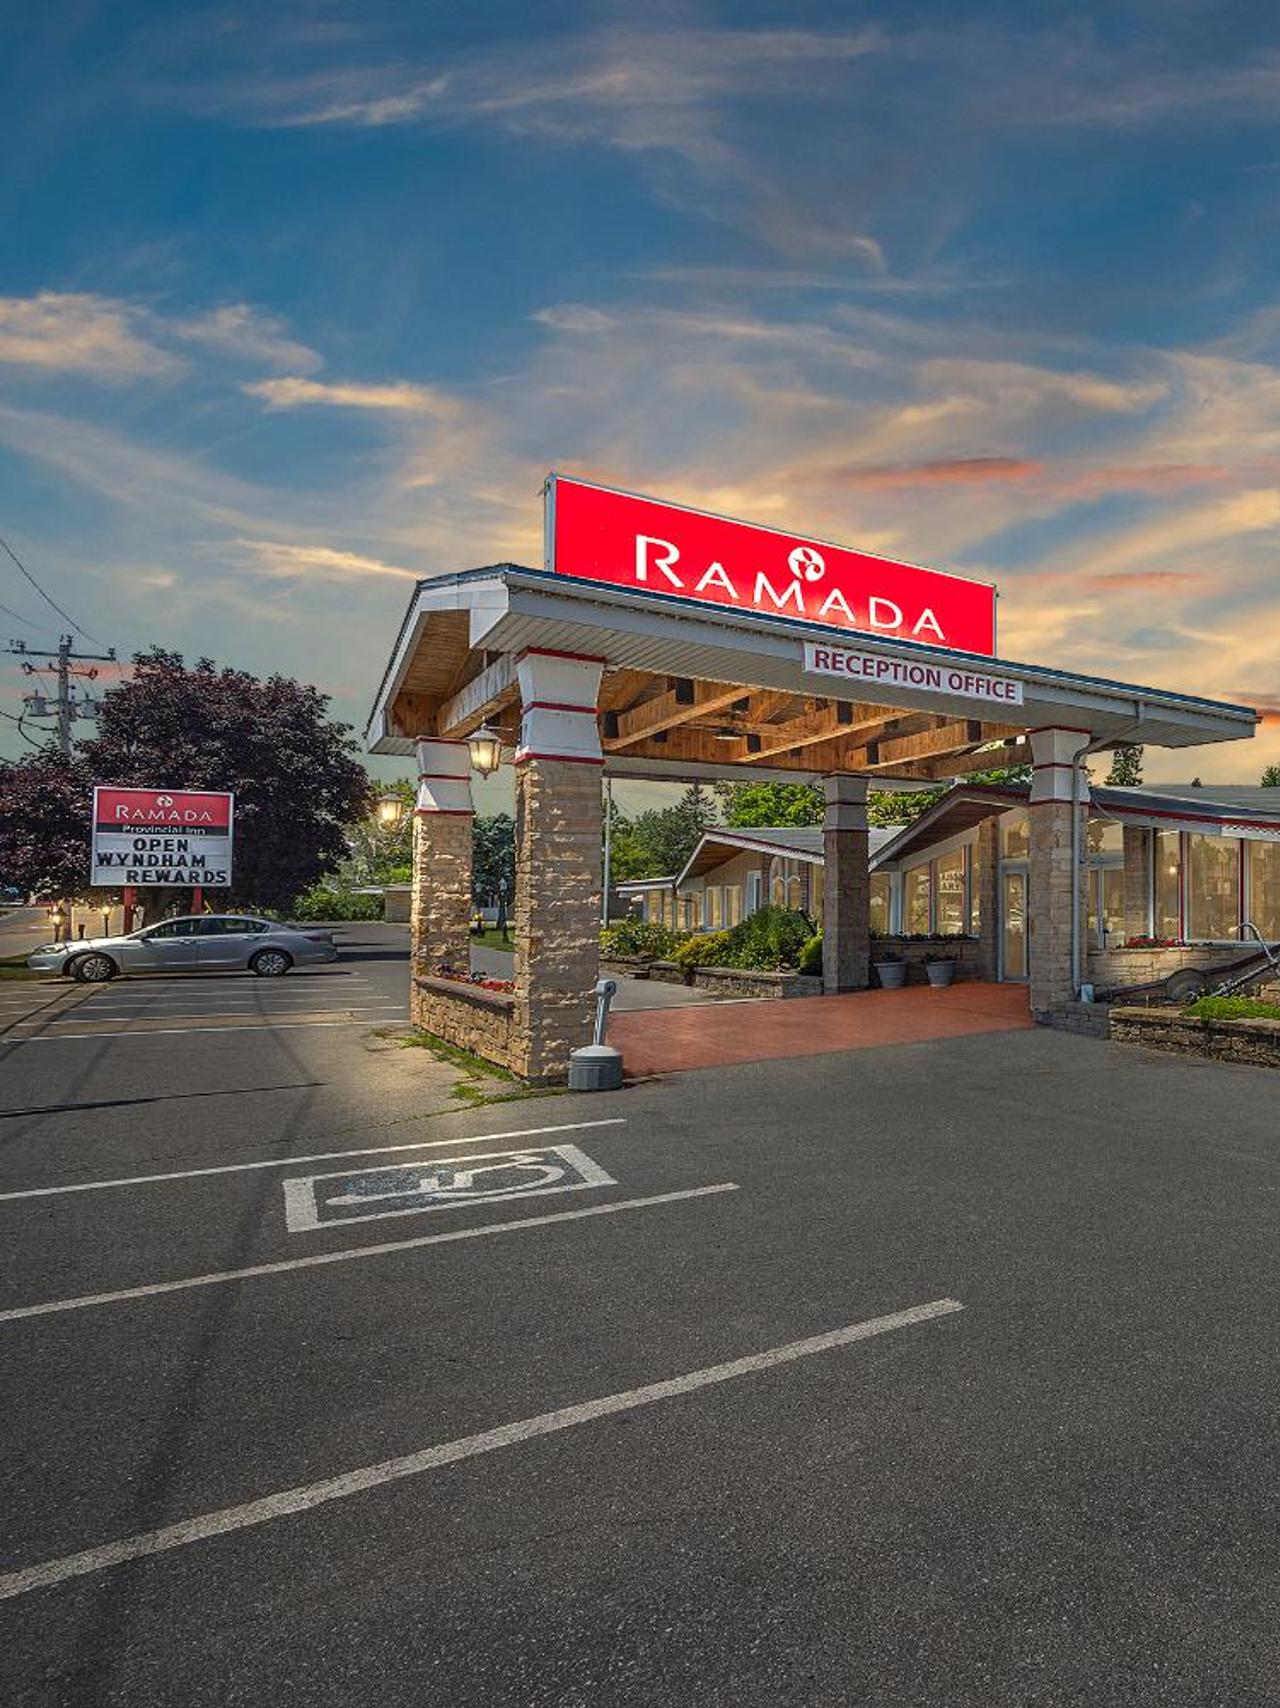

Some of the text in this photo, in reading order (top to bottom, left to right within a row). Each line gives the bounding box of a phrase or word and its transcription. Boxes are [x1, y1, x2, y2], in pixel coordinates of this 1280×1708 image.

[635, 535, 946, 641] RAMADA
[814, 648, 1017, 701] RECEPTION OFFICE
[115, 804, 213, 822] RAMADA
[122, 824, 182, 834] Provincial
[132, 838, 189, 852] OPEN
[97, 852, 206, 867] WYNDHAM
[126, 869, 227, 883] REWARDS
